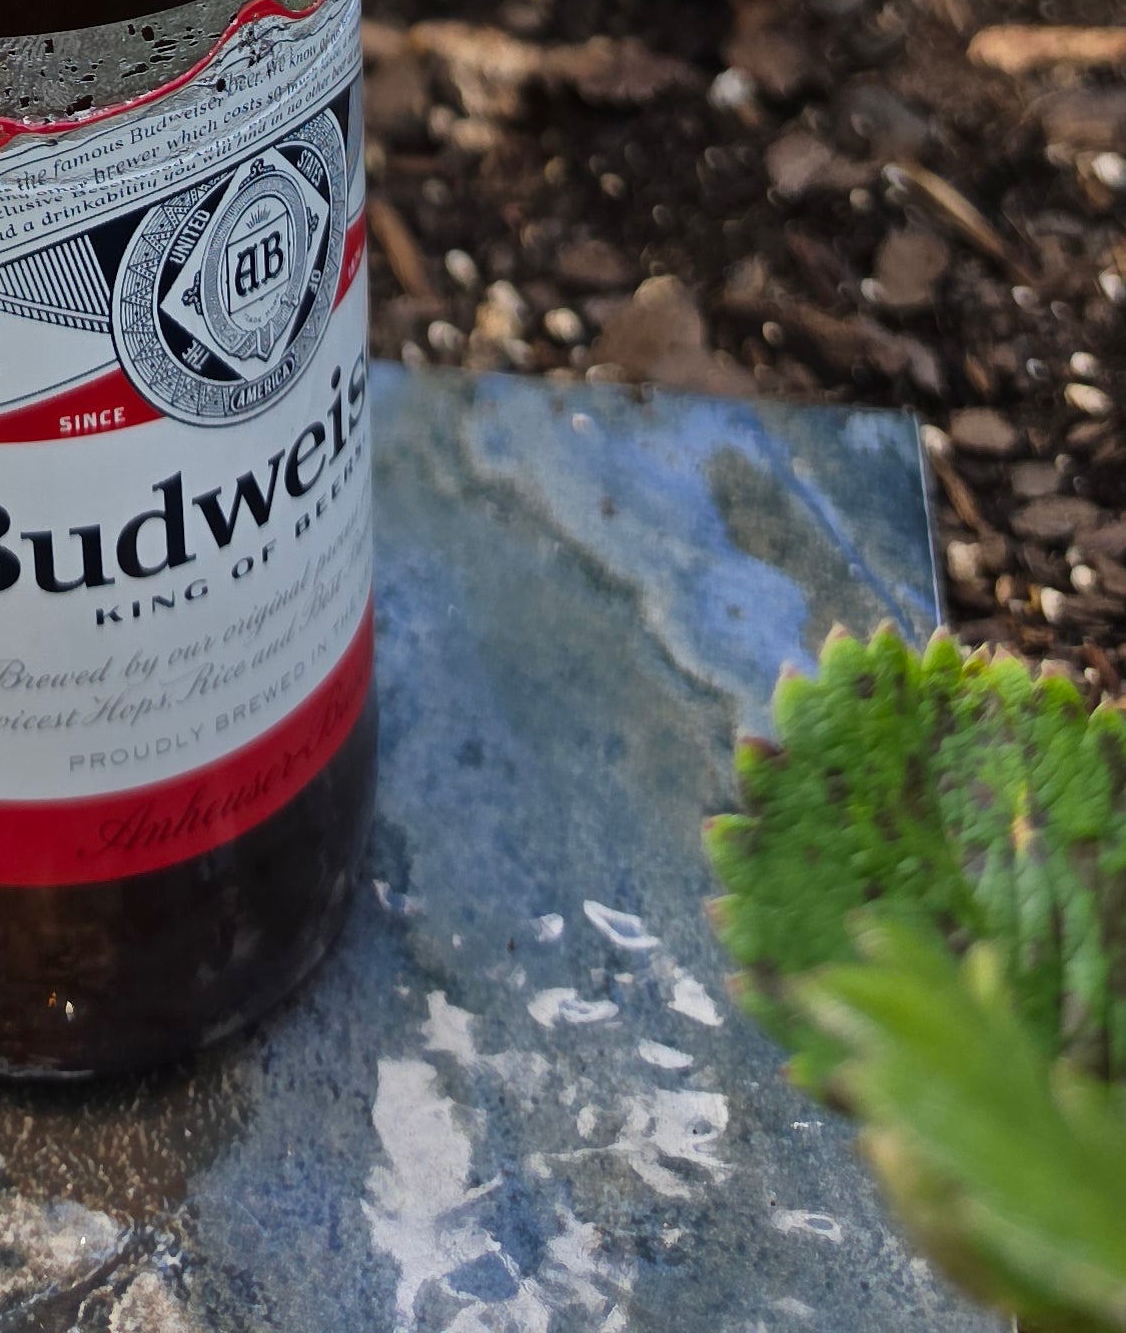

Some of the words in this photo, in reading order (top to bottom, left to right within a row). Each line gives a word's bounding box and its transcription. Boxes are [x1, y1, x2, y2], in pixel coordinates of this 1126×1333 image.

[23, 219, 35, 233] a
[41, 178, 158, 226] drinkability
[163, 162, 197, 182] you
[270, 110, 283, 127] in
[53, 139, 124, 177] famous
[130, 95, 225, 146] Budweiser
[93, 145, 160, 185] brewer
[166, 119, 218, 151] which
[223, 94, 263, 124] costs
[296, 148, 325, 188] STATES
[170, 208, 211, 265] UNITED
[234, 229, 285, 298] AB
[58, 406, 126, 435] SINCE
[235, 360, 294, 408] AMERICA
[95, 579, 209, 626] KING
[231, 538, 277, 580] OF
[124, 647, 160, 683] by
[167, 634, 216, 666] our
[222, 558, 311, 641] original
[177, 661, 247, 704] Rice
[251, 612, 298, 671] and
[69, 723, 204, 773] PROUDLY
[214, 660, 306, 733] BREWED
[311, 642, 328, 666] IN
